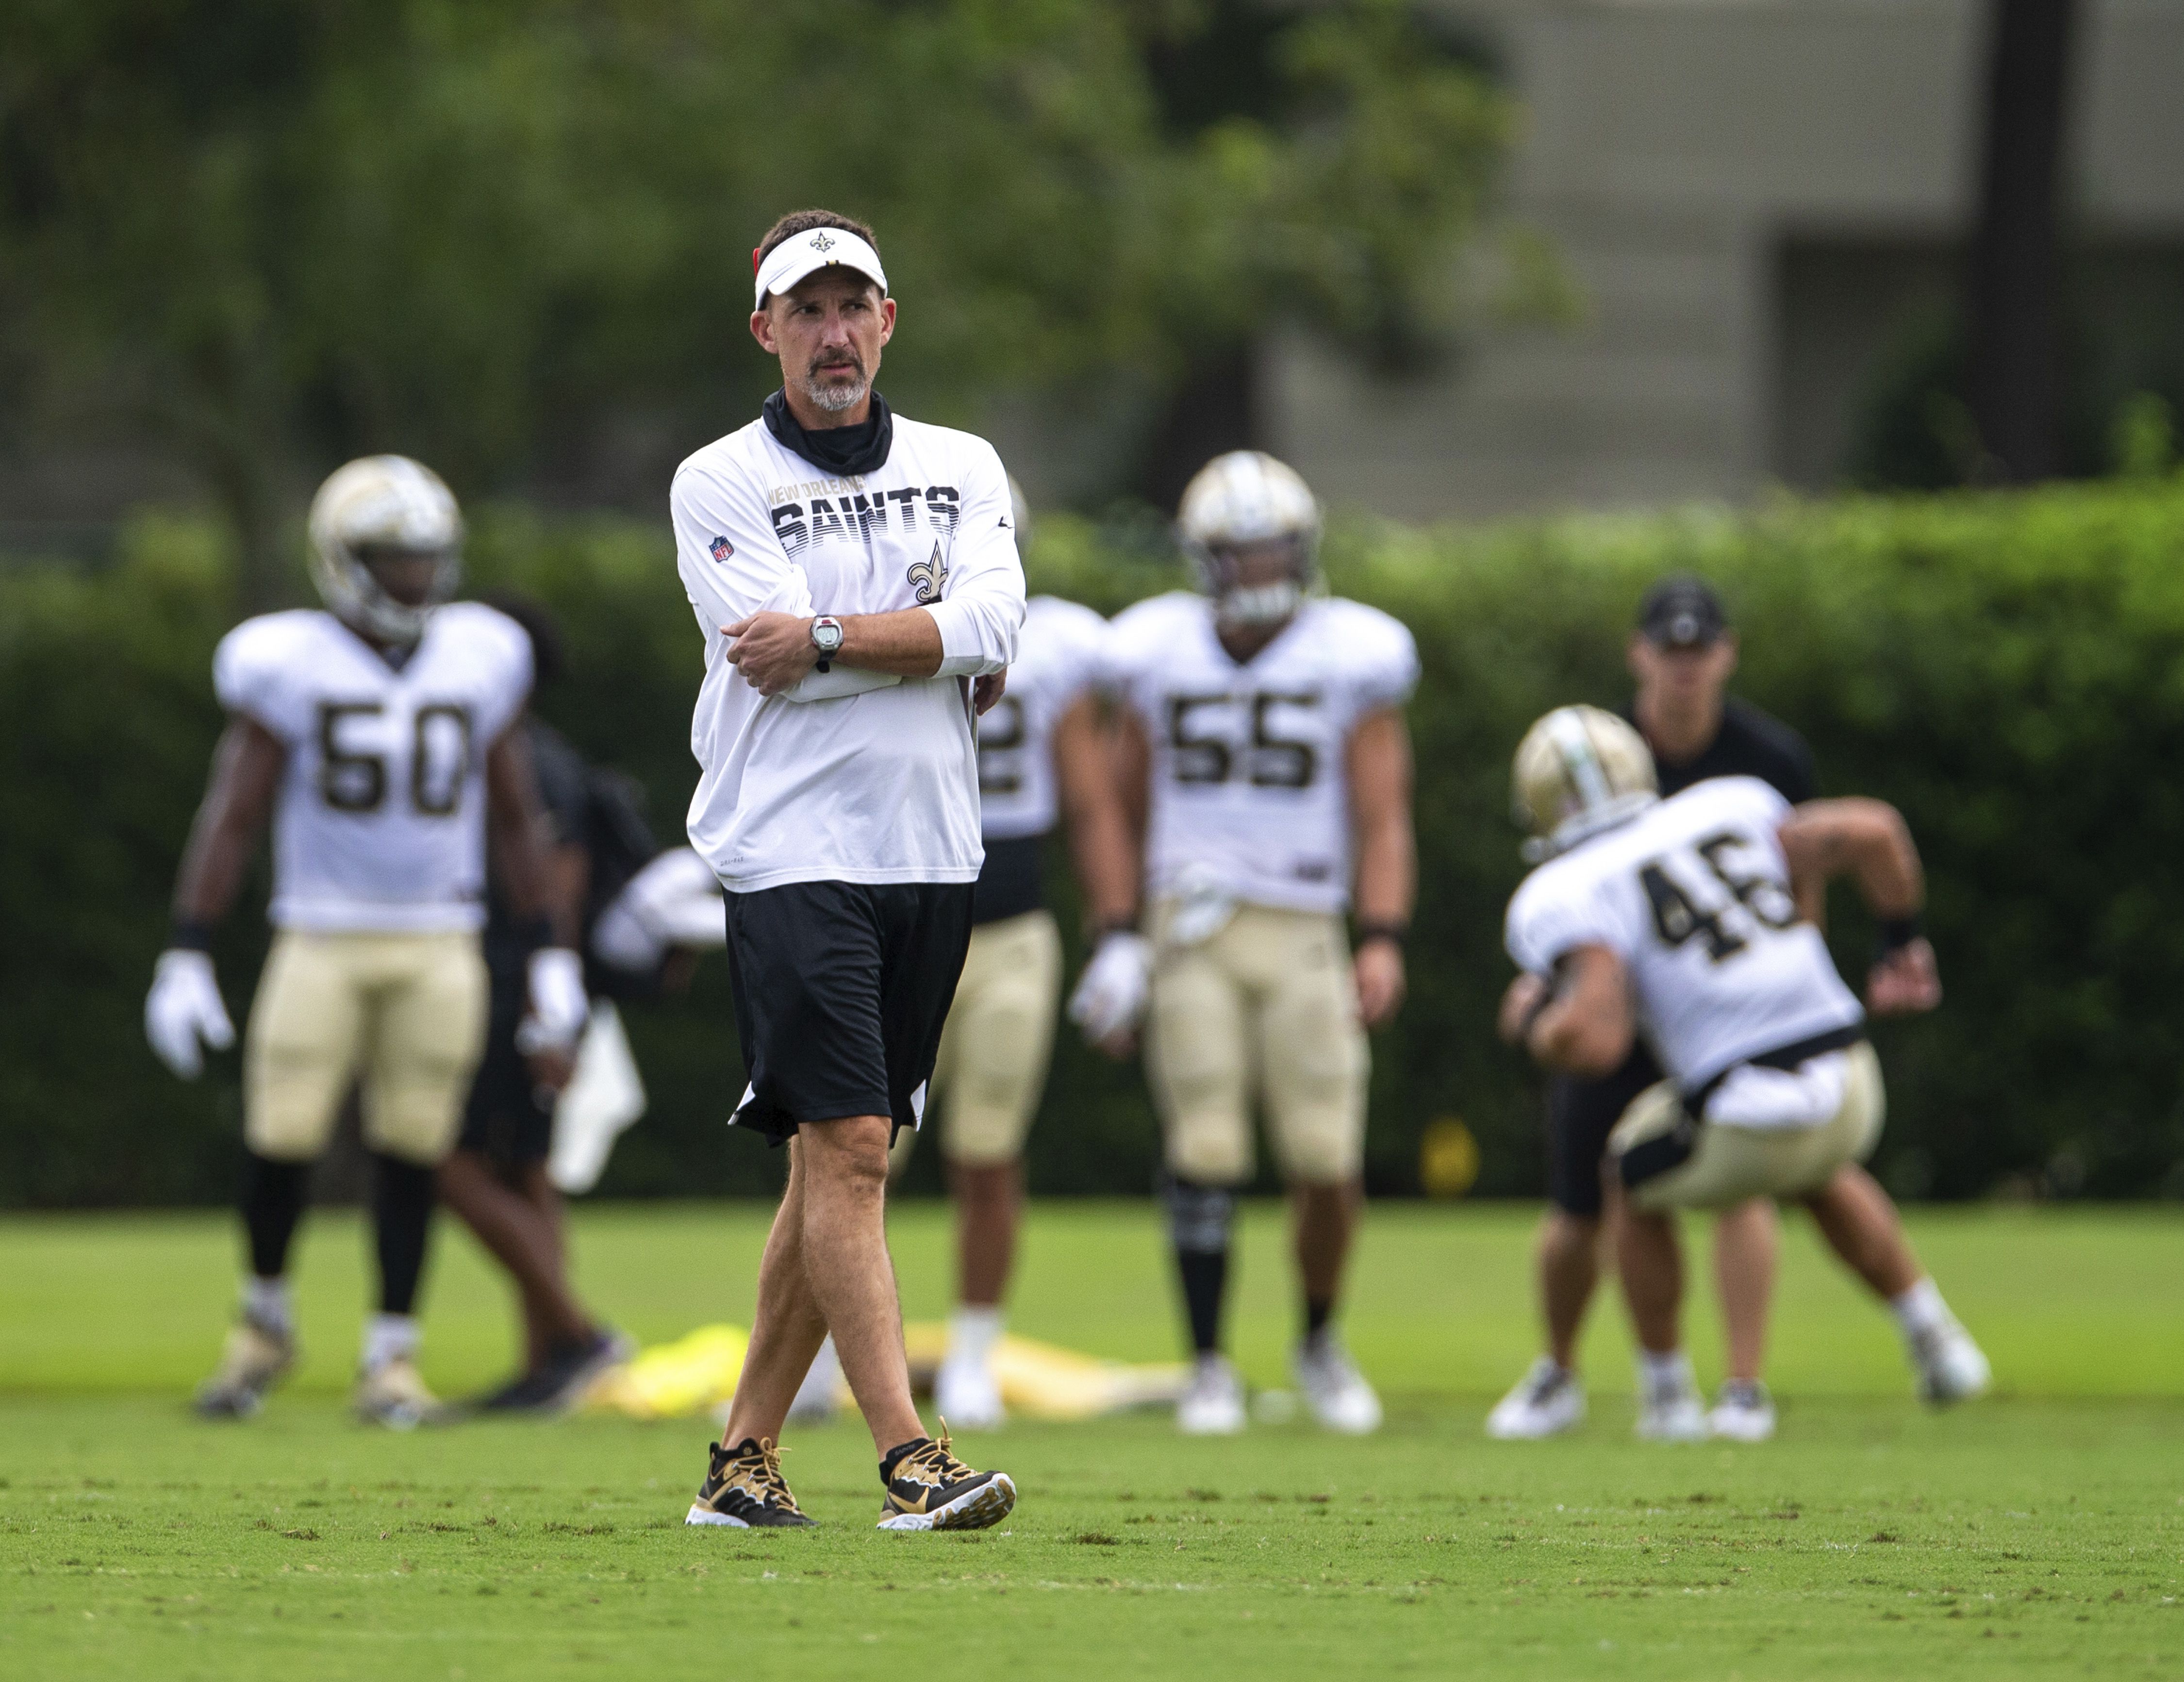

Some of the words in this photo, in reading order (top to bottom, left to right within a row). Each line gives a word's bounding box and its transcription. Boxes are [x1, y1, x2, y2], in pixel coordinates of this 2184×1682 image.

[768, 485, 800, 505] NEW
[800, 475, 867, 498] ORLEANS
[771, 486, 960, 558] SAINTS
[714, 544, 732, 560] NFL
[315, 701, 473, 816] 50
[1168, 690, 1318, 787] 55
[1639, 832, 1797, 965] 46
